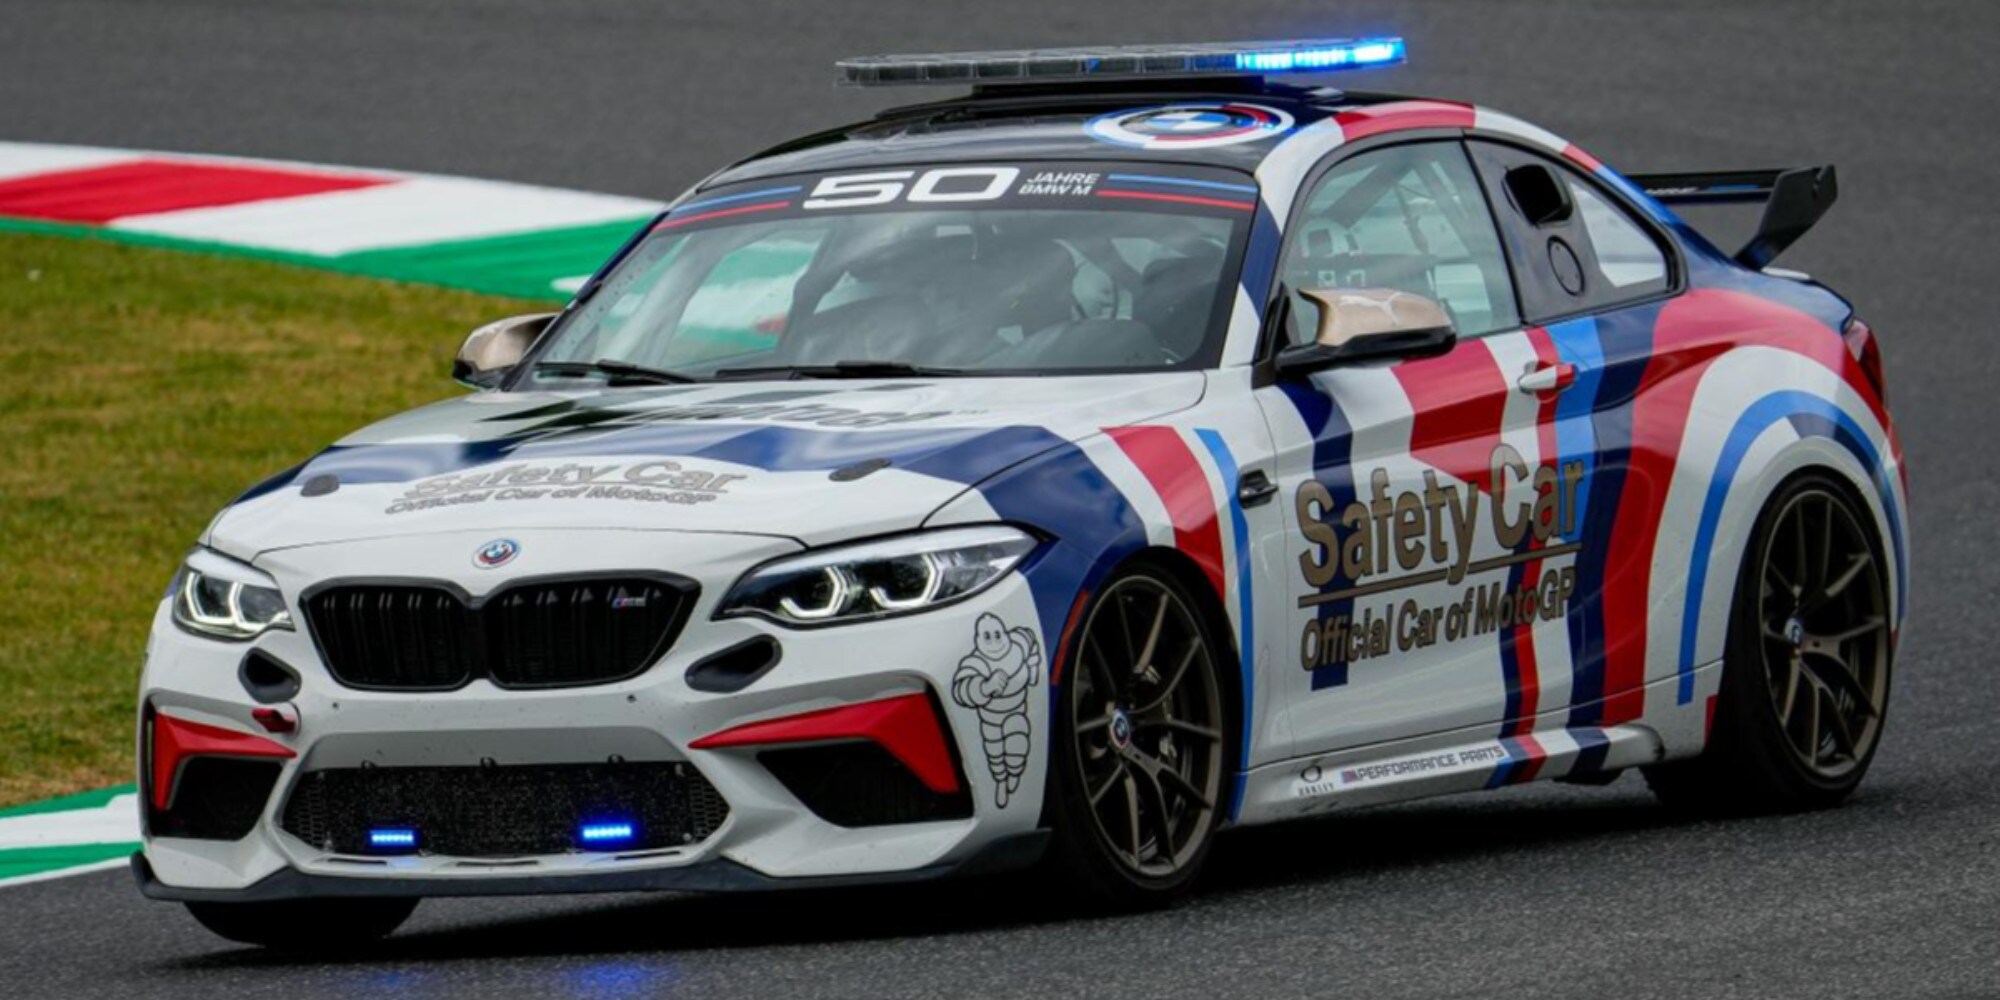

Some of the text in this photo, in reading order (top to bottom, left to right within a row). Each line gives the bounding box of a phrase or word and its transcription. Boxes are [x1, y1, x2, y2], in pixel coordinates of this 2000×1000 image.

[803, 167, 1020, 210] 50
[1018, 183, 1093, 196] BMW M
[1026, 172, 1100, 184] JAHRE
[404, 460, 749, 499] Safety Car
[385, 484, 718, 514] Official Car of MotoGP
[1295, 443, 1584, 588] Safety Car
[1301, 566, 1576, 672] Official Car of MotoGP
[1355, 746, 1505, 781] PERFORMANCE PARTS
